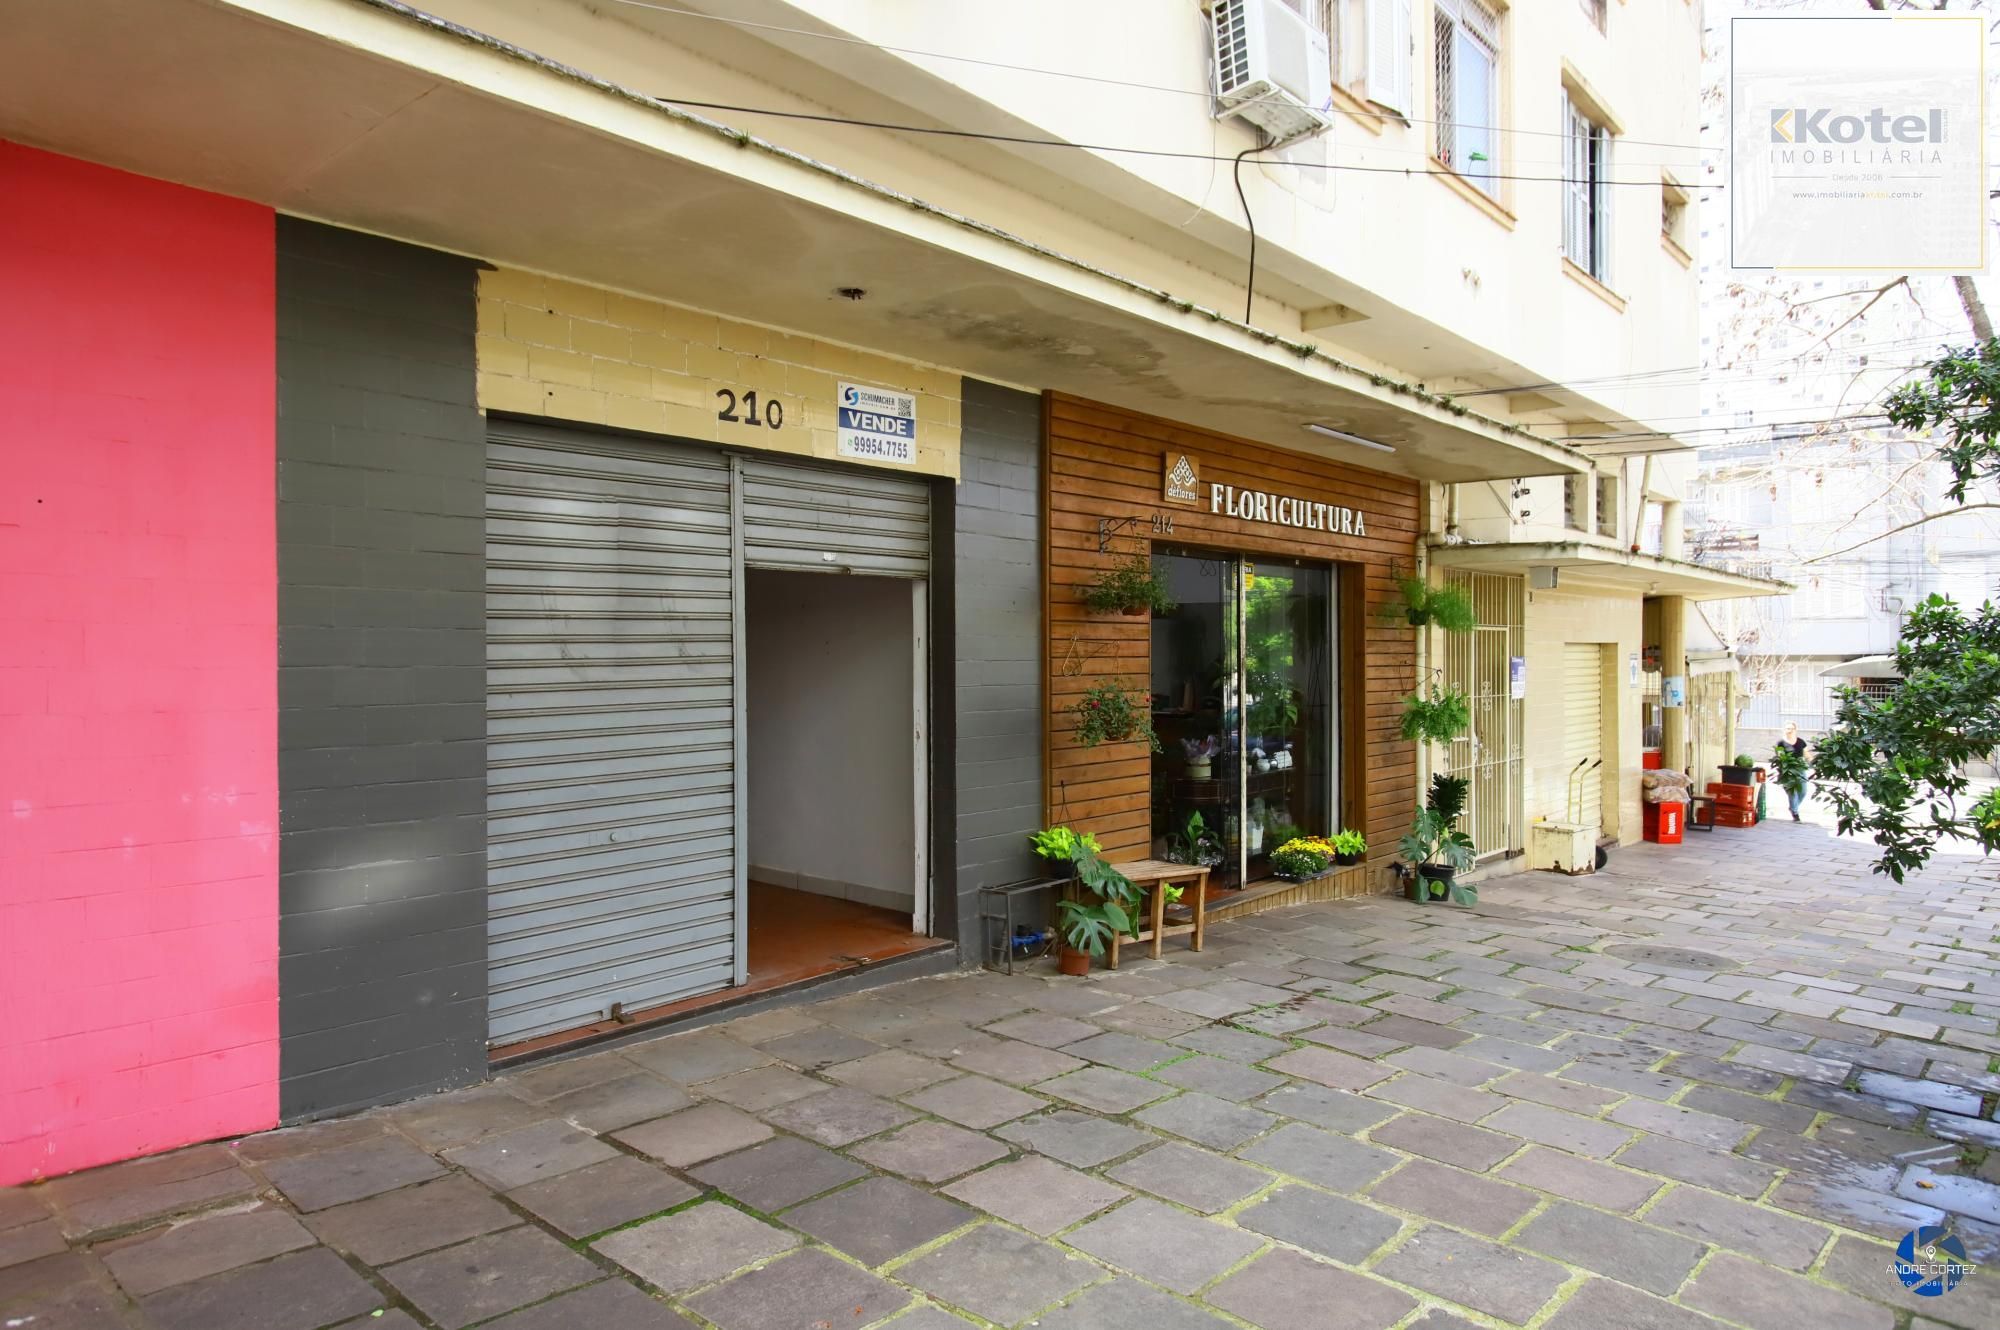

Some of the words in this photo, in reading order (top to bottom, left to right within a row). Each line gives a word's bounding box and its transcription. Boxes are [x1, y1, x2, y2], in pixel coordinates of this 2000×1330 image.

[716, 389, 783, 430] 210
[860, 391, 896, 407] SCHUMACHER
[847, 410, 907, 436] VENDE
[854, 435, 908, 459] 99954.7755
[1210, 483, 1367, 537] FLORICULTURA
[1151, 513, 1175, 536] 214
